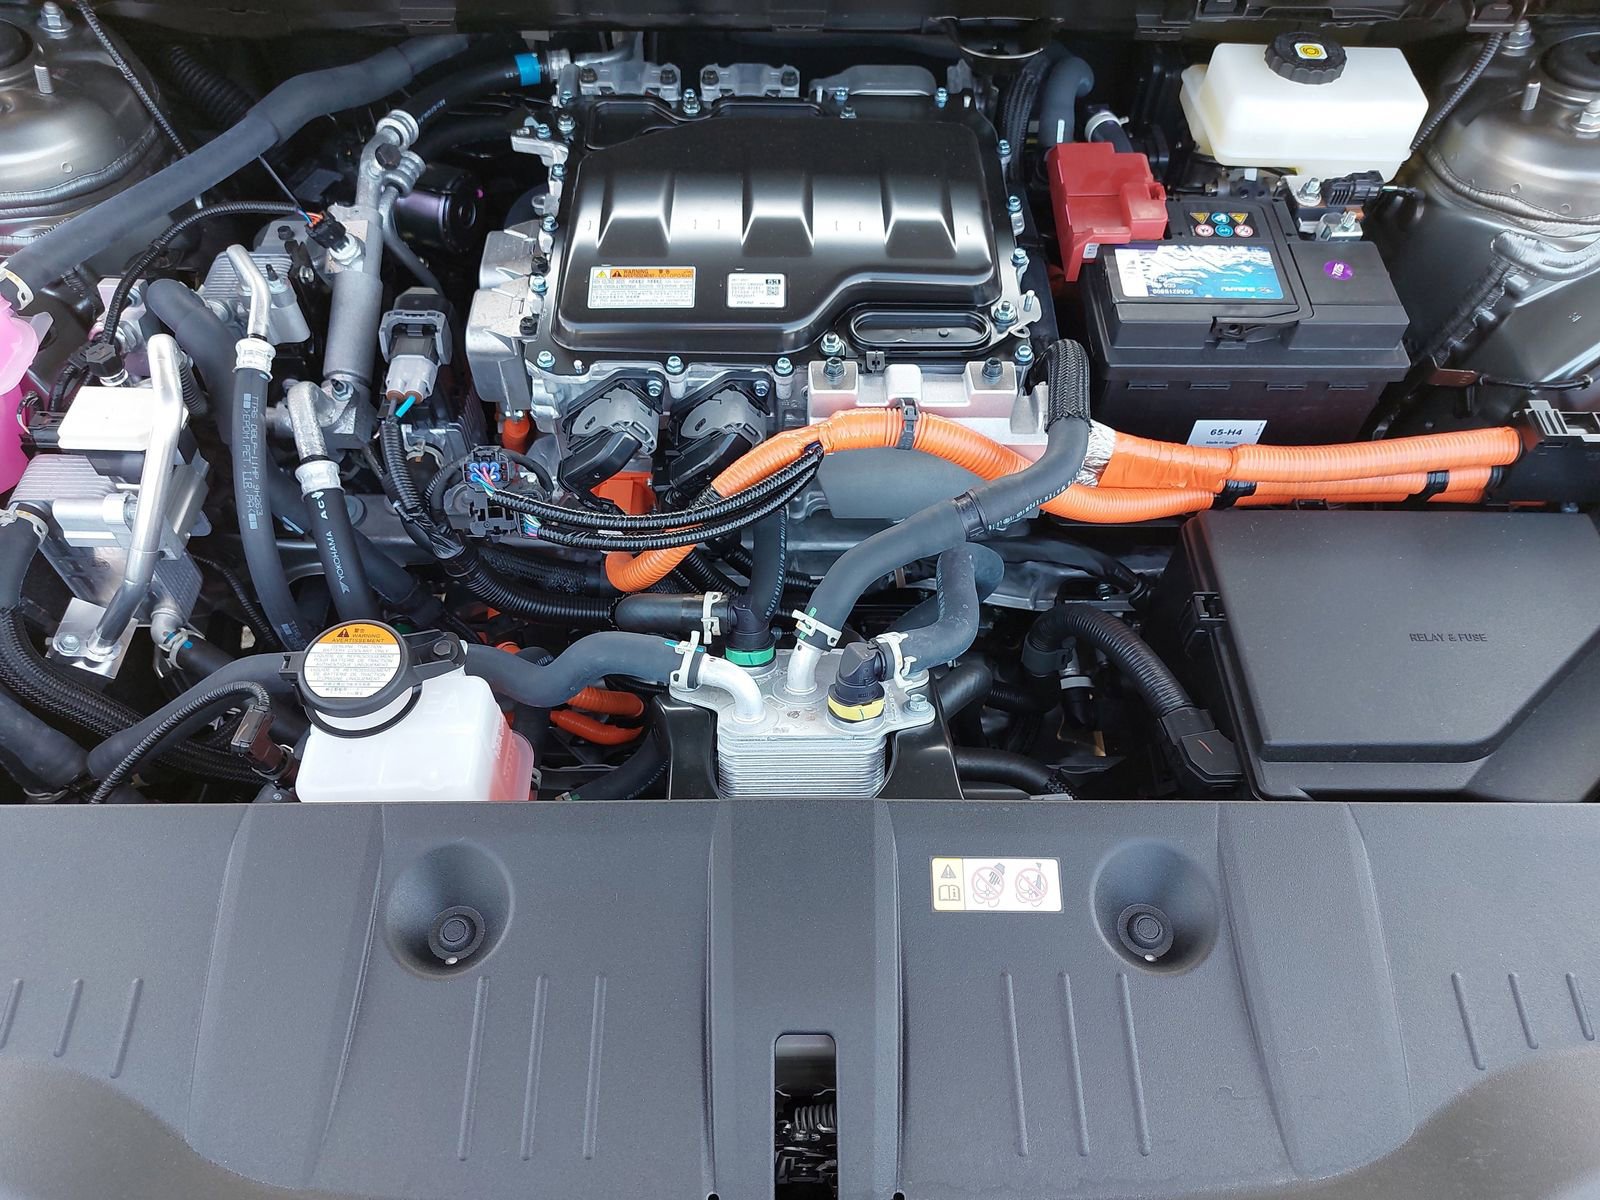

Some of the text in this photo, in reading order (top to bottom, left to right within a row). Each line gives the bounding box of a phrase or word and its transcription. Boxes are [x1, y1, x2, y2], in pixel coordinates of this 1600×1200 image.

[326, 530, 345, 581] YOKOHAMA
[1409, 633, 1488, 642] RELAY & FUSE
